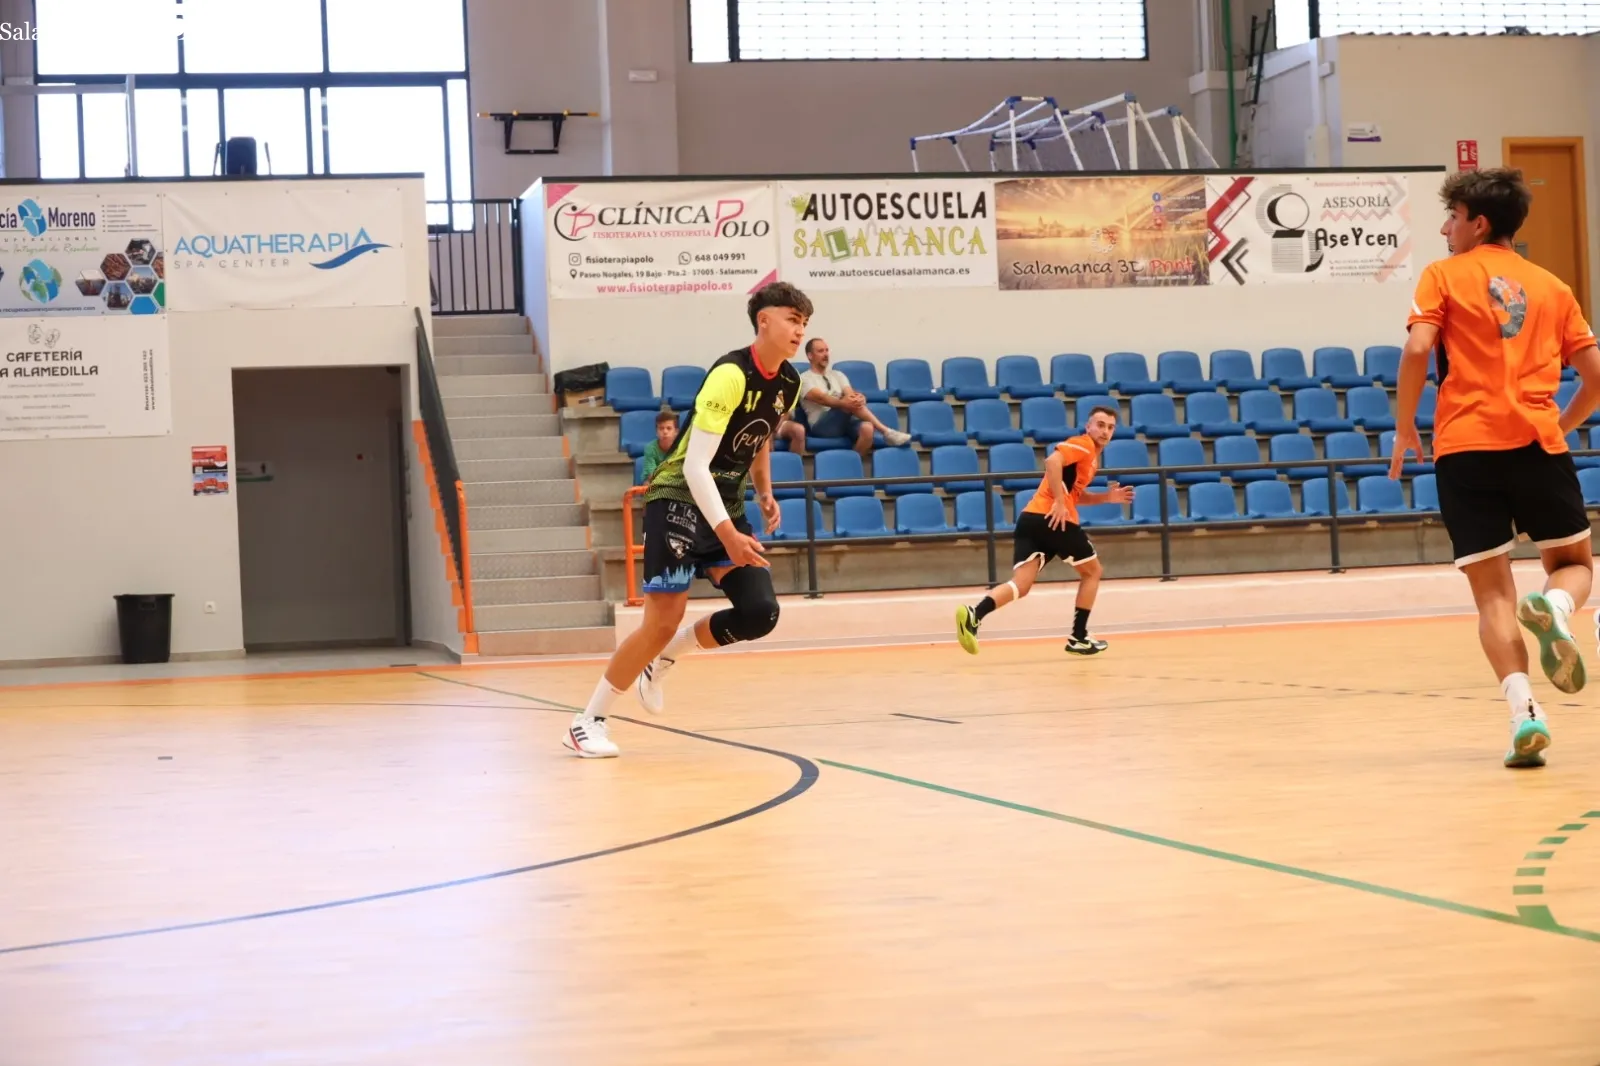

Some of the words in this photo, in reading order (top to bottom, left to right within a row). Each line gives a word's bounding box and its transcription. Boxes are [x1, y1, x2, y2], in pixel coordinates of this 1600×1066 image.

[801, 190, 987, 221] AUTOESCUELA
[1322, 192, 1391, 209] ASESORÍA
[48, 207, 96, 228] Moreno
[598, 201, 711, 226] CLÍNICA
[714, 199, 770, 238] POLO
[593, 231, 652, 239] FISIOTERAPIA
[173, 227, 379, 258] AQUATHERAPIA
[793, 225, 987, 263] SALAMANCA
[173, 260, 205, 269] SPA
[218, 258, 290, 268] CENTER
[585, 254, 654, 266] fisioterapiapolo
[694, 254, 712, 262] 648
[713, 253, 730, 261] 049
[730, 252, 746, 261] 991
[809, 267, 970, 277] www.autoescuelasalamanca.es
[1012, 259, 1113, 276] Salamanca
[1150, 256, 1194, 274] Print
[579, 271, 601, 279] Paseo
[602, 271, 634, 280] Nogales,
[646, 270, 662, 279] Bajo
[719, 267, 758, 276] Salamanca
[597, 280, 733, 294] www.fisioterapiapolo.es
[7, 347, 83, 362] CAFETERÍA
[13, 365, 99, 378] ALAMEDILLA
